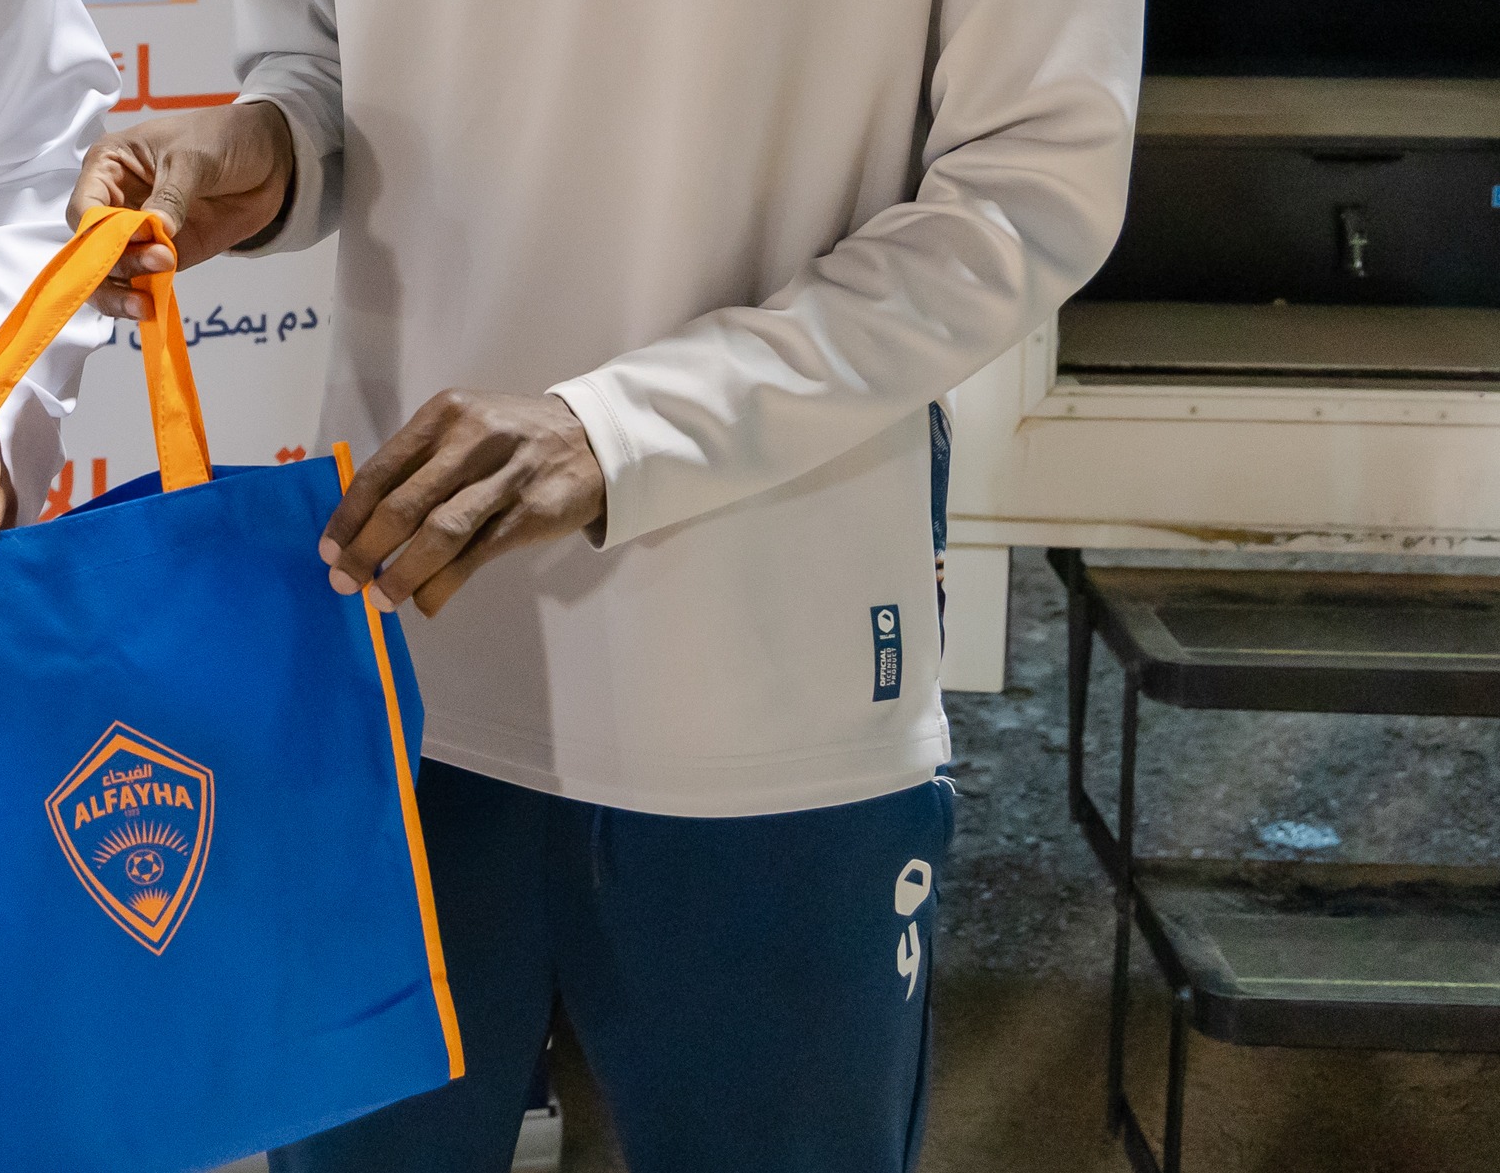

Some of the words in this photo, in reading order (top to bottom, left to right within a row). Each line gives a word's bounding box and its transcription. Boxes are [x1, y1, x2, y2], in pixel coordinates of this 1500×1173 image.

[879, 648, 887, 687] OFFICIAL
[102, 763, 153, 787] الفيحاء
[74, 782, 195, 831] ALFAYHA
[897, 920, 921, 1002] 4
